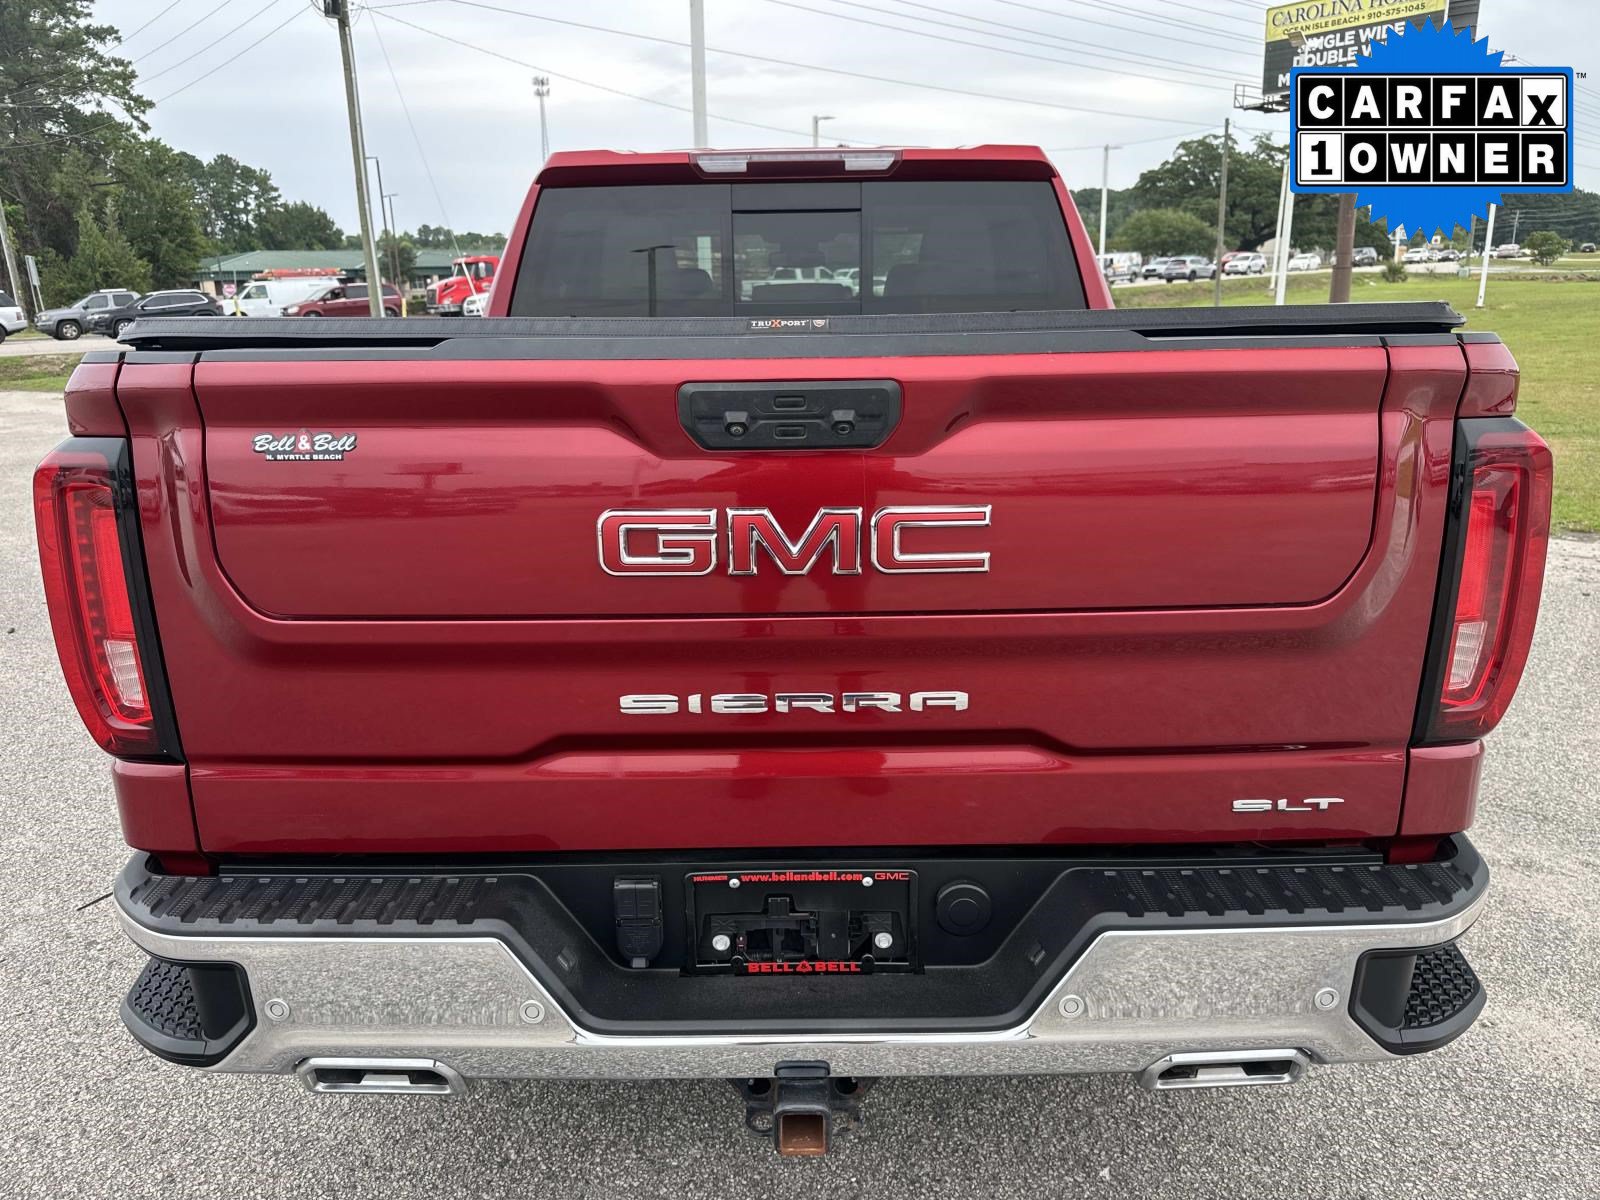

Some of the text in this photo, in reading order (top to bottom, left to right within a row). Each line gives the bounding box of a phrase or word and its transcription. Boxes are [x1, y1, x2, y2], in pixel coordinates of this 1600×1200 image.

[1272, 0, 1362, 27] CAROLINA
[1312, 20, 1330, 30] ISLE
[1331, 15, 1360, 27] BEACH
[1367, 3, 1426, 20] 910-575-1045
[751, 320, 807, 328] TRUXPORT
[253, 434, 356, 451] Bell & Bell
[597, 504, 992, 576] GMC
[619, 691, 969, 714] SIERRA
[1232, 797, 1345, 811] SLT
[740, 871, 863, 883] www.bellandbell.com
[874, 872, 910, 881] GMC
[747, 961, 793, 973] BELL
[815, 961, 861, 973] BELL
